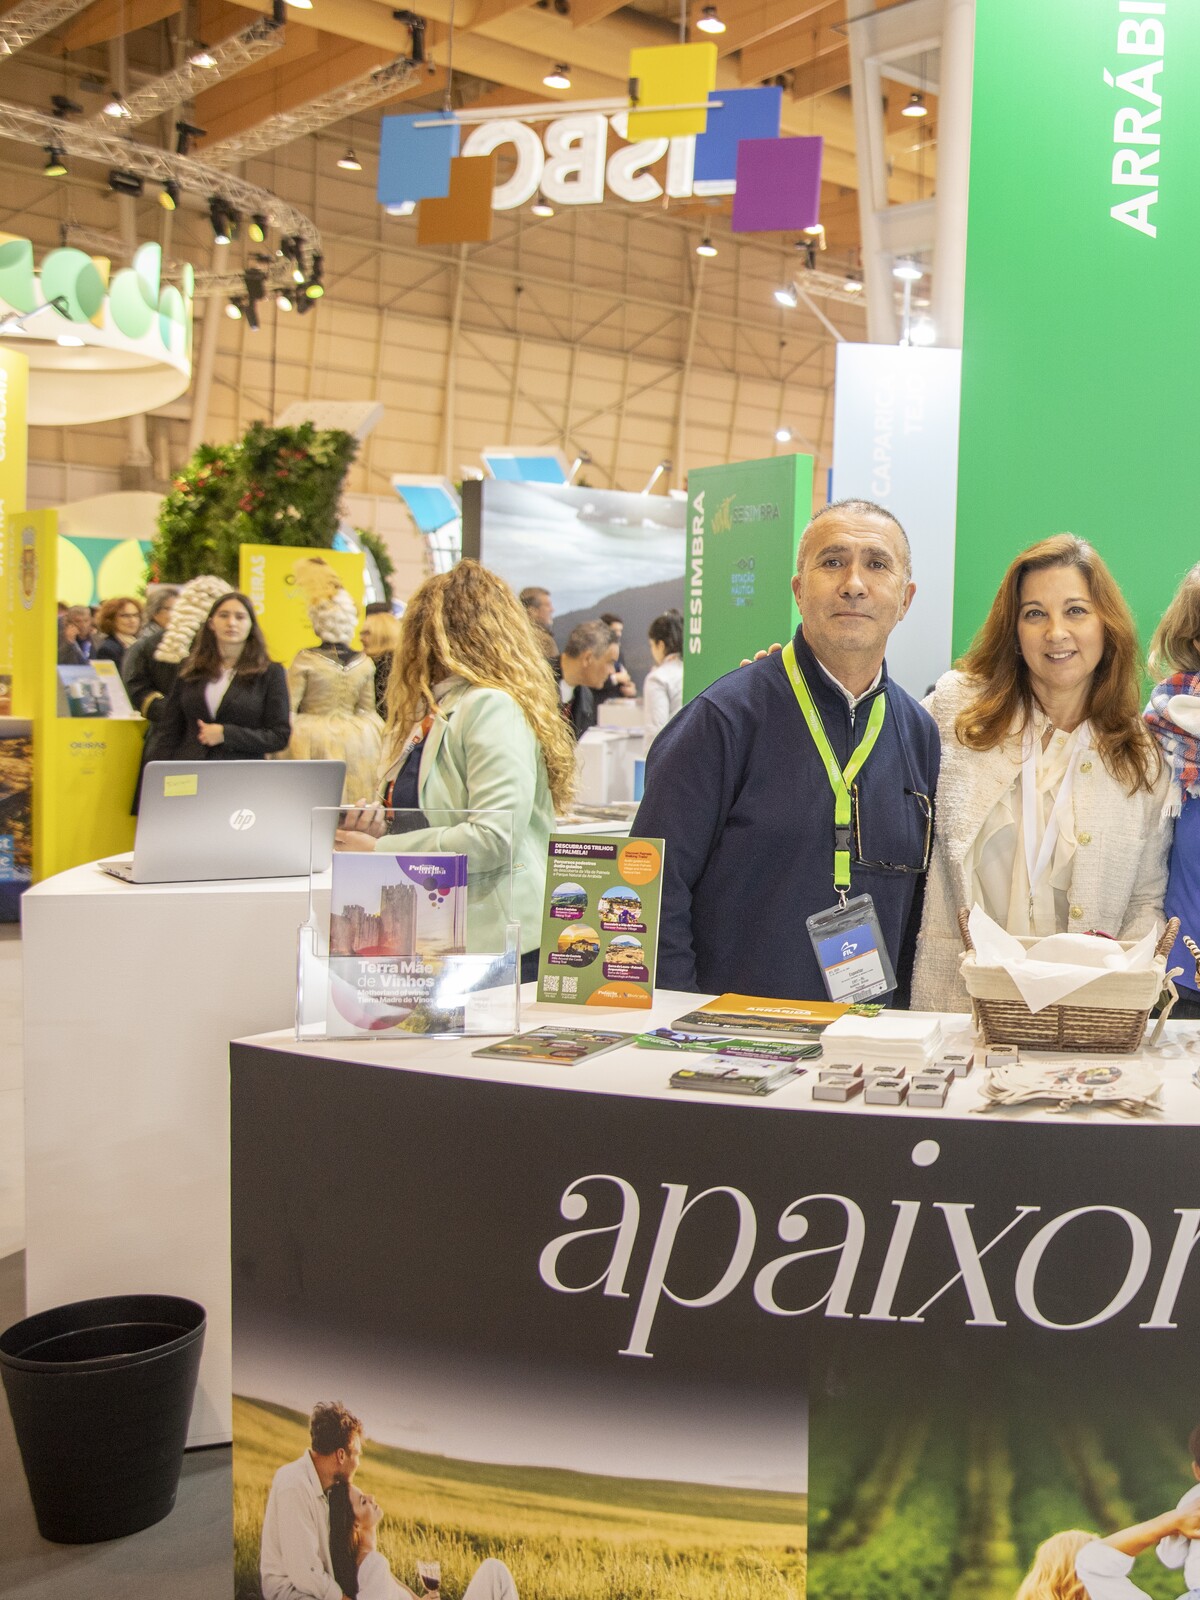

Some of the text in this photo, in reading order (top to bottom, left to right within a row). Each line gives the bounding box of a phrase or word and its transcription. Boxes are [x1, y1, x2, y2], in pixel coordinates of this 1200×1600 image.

[689, 491, 705, 654] SESIMBRA
[842, 949, 854, 957] FIL
[358, 960, 433, 974] Terra Mãe
[357, 974, 435, 988] de Vinhos
